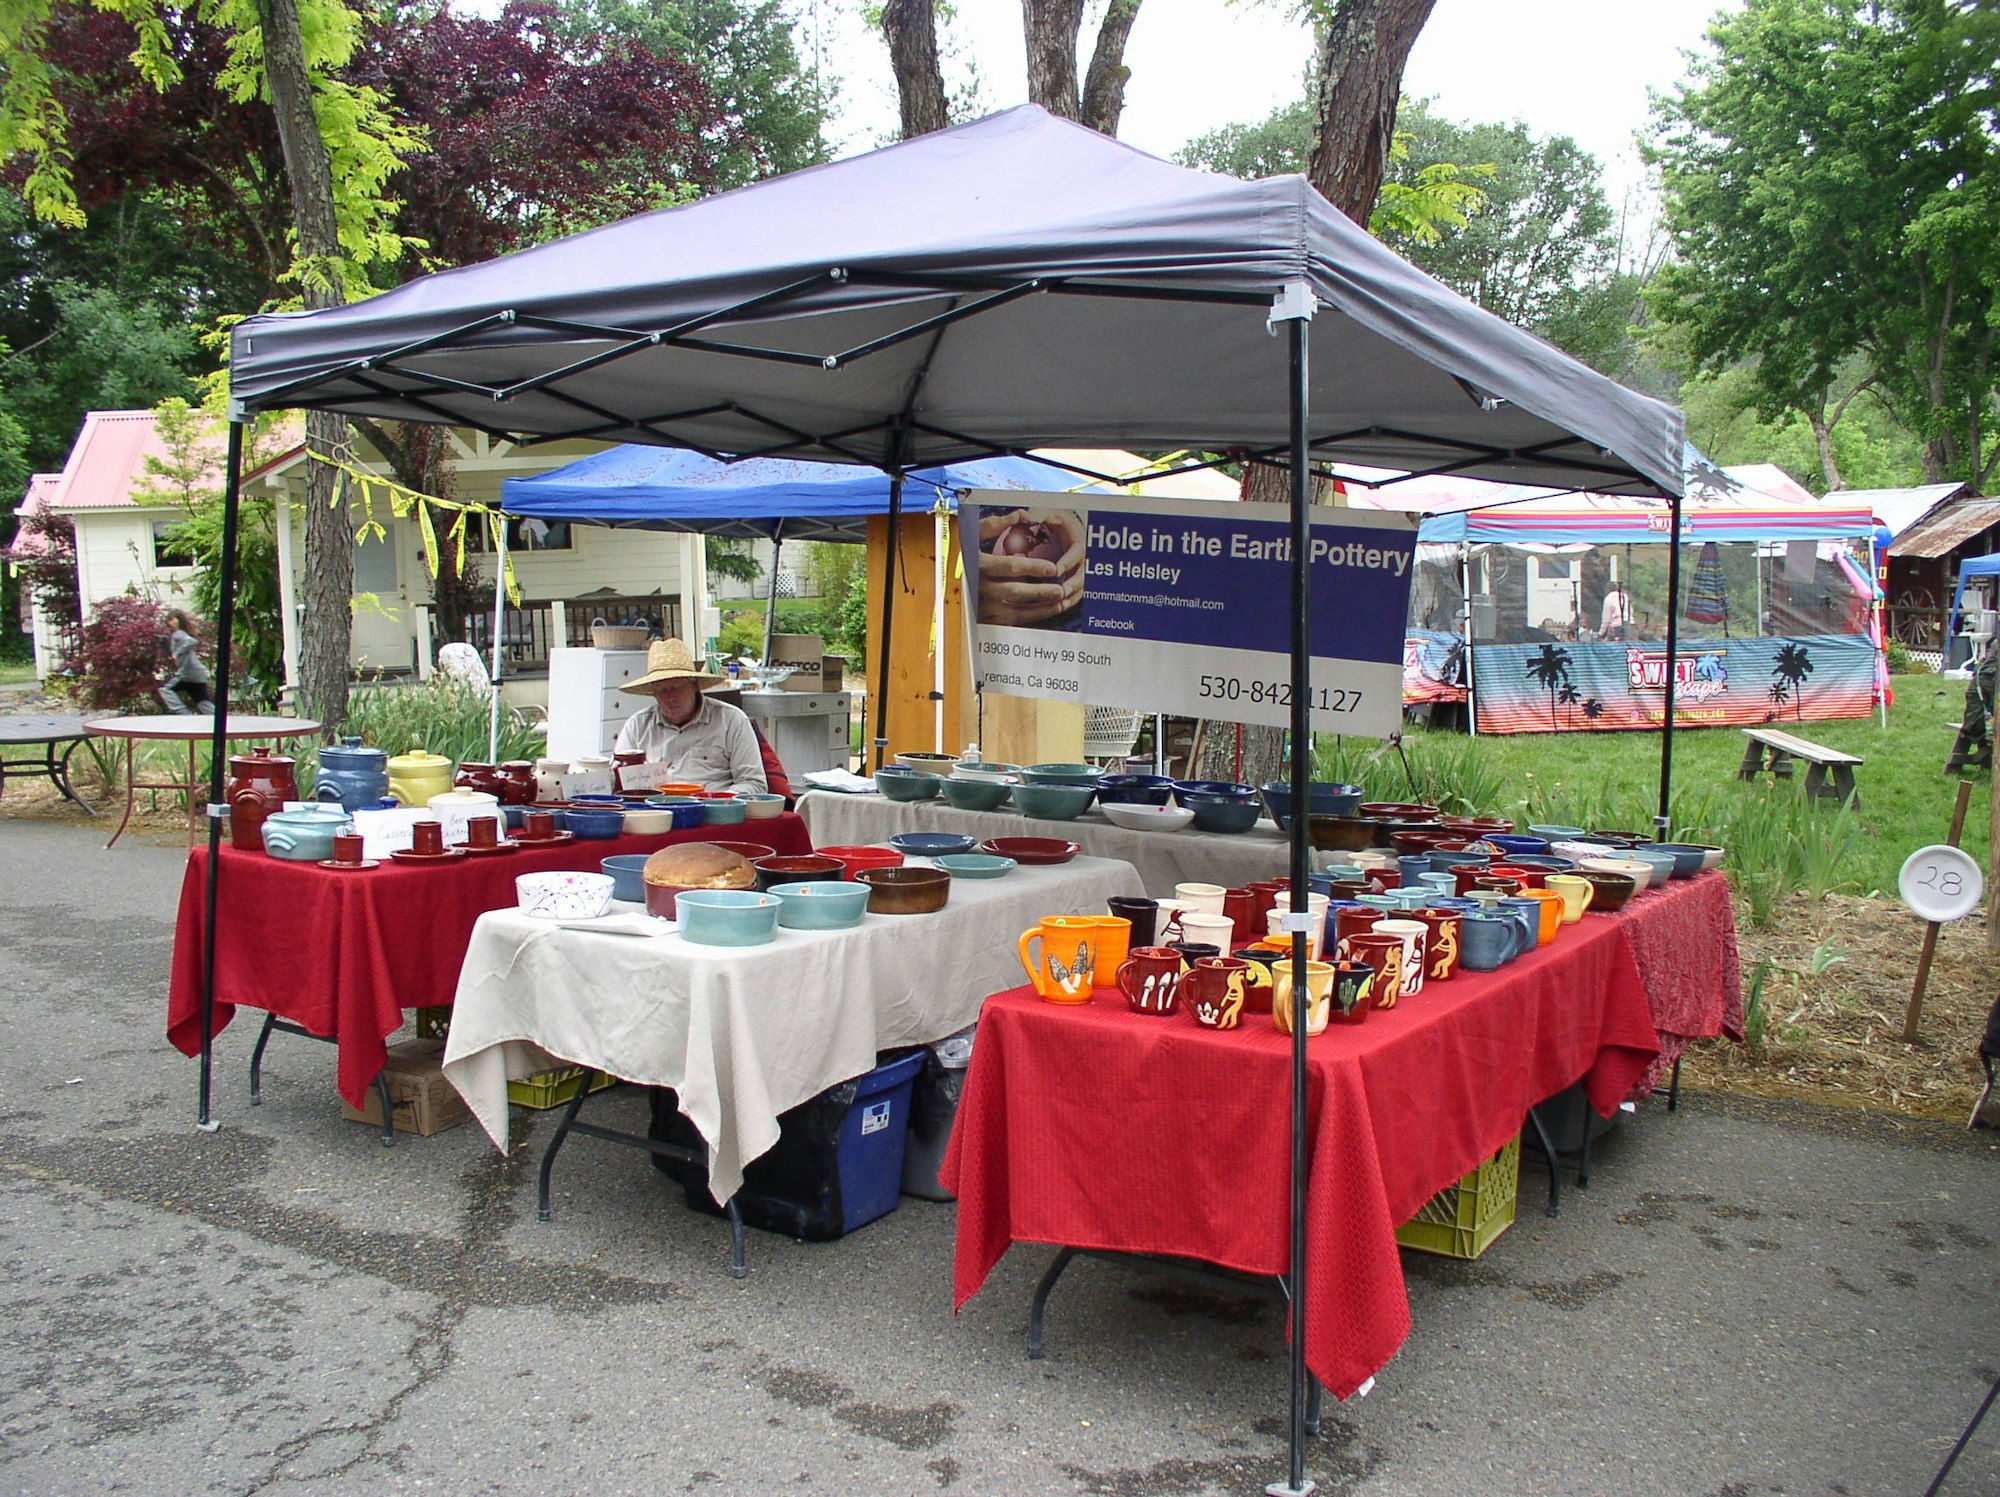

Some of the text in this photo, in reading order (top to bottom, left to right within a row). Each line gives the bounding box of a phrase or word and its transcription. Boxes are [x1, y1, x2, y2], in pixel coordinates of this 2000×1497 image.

[1087, 524, 1143, 551] Hole
[1152, 528, 1173, 553] in
[1181, 530, 1222, 557] the
[1309, 539, 1410, 577] Pottery
[1084, 558, 1181, 585] Les Helsley
[1082, 589, 1225, 611] mommatomma@hotmail.com
[1088, 616, 1135, 631] Facebook
[978, 641, 1112, 666] 13909 Old Hwy 99 South
[981, 671, 1079, 693] renada, Ca 96038
[1916, 866, 1963, 896] 28
